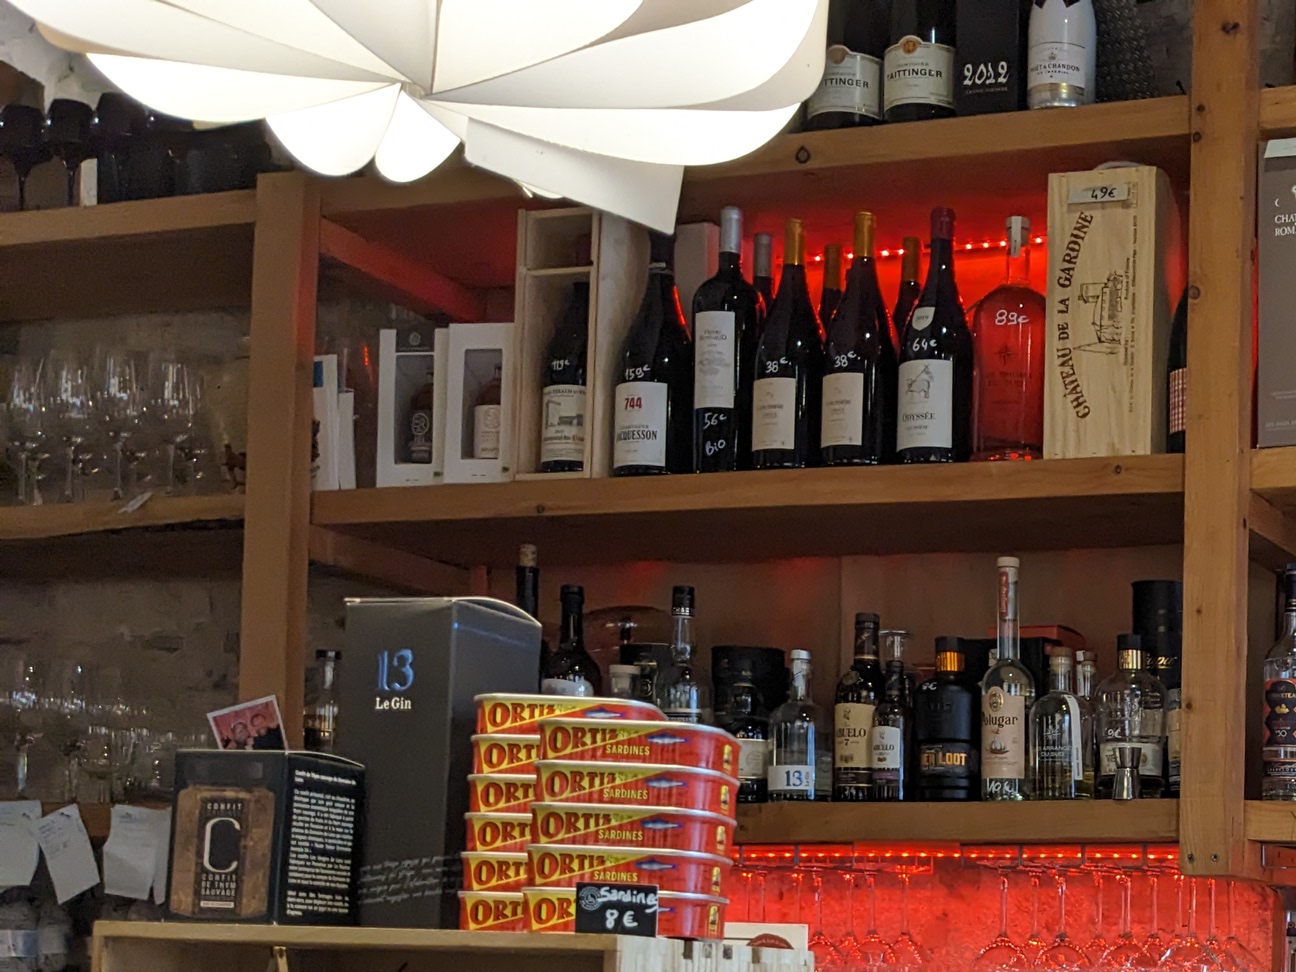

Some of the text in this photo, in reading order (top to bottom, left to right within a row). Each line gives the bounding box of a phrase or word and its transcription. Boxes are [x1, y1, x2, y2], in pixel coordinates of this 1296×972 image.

[886, 67, 943, 81] TAITTINGER
[963, 61, 1009, 86] 2012
[1091, 187, 1116, 200] 49€
[995, 310, 1029, 325] 89€
[1057, 212, 1094, 419] CHÂTEAU DE LA GARDINE
[912, 338, 937, 351] 64€
[625, 365, 650, 380] 159€
[624, 397, 642, 410] 744
[703, 413, 727, 429] 56€
[376, 649, 415, 691] 13
[375, 697, 411, 710] Le Gin
[982, 711, 1019, 729] Polugar
[549, 726, 619, 752] ORTIZ
[483, 742, 540, 768] ORTI
[606, 744, 650, 756] SARDINES
[939, 752, 968, 765] LOOT
[545, 771, 616, 798] ORTIZ
[785, 770, 803, 787] 13
[480, 781, 536, 807] ORTI
[603, 788, 648, 799] SARDINES
[207, 802, 243, 811] CONFIT
[540, 811, 612, 838] ORTIZ
[598, 830, 643, 841] SARDINES
[473, 859, 528, 886] ORTI
[536, 852, 605, 879] ORTIZ
[593, 870, 638, 882] SARDINES
[469, 899, 525, 925] ORTI
